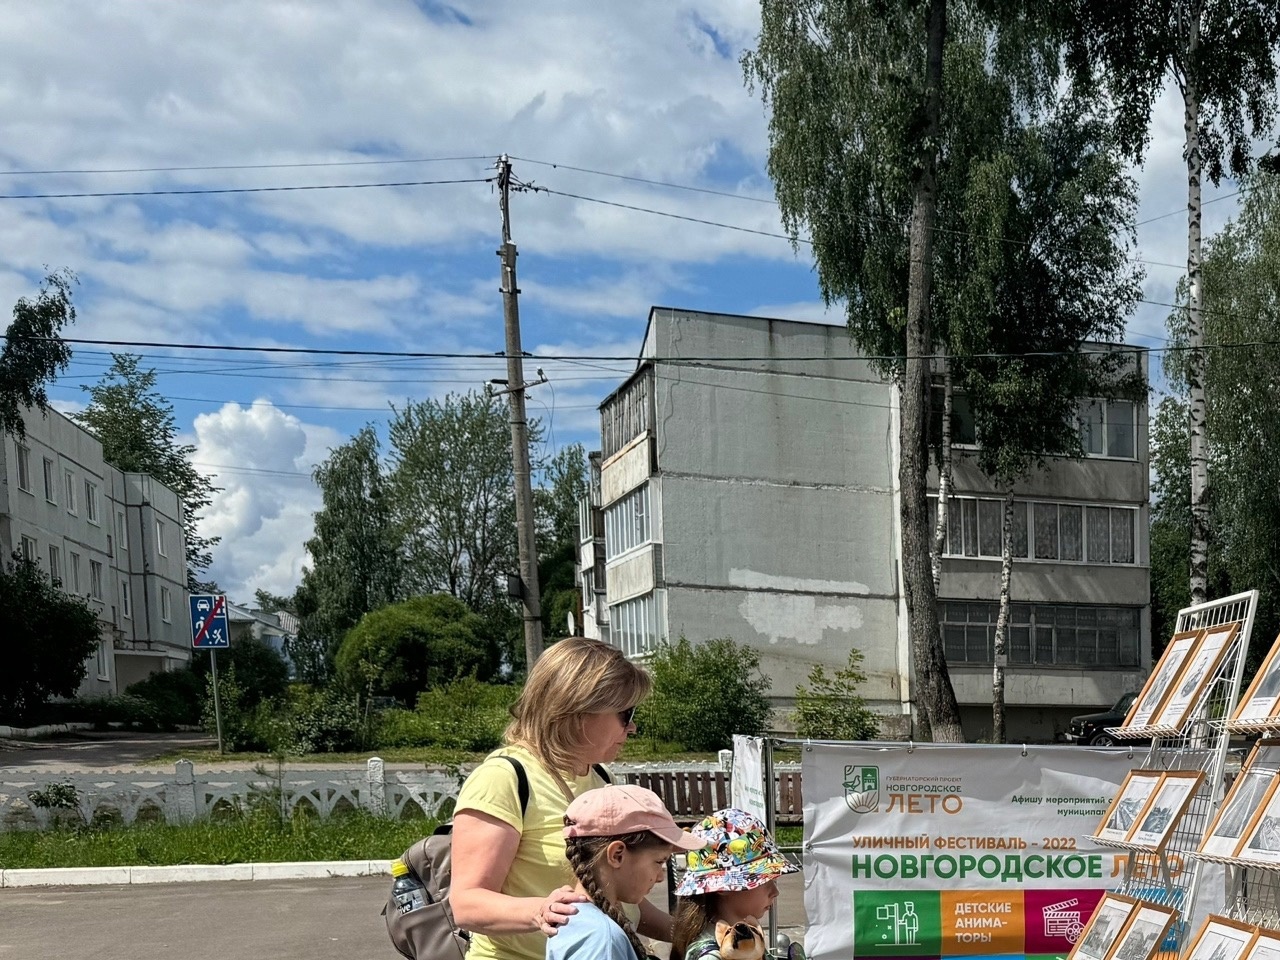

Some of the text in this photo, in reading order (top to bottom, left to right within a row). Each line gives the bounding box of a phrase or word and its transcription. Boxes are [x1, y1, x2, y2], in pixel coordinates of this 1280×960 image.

[886, 784, 962, 793] НОВГОРОДСКОЕ
[885, 793, 963, 815] ЛЕТО
[1011, 795, 1043, 805] Афишу
[1045, 797, 1106, 805] мероприятий
[1057, 808, 1107, 817] муниципал
[852, 833, 930, 850] УЛИЧНЫЙ
[933, 836, 1028, 850] ФЕСТИВАЛЬ
[1042, 837, 1077, 850] 2022
[852, 854, 1185, 883] НОВГОРОДСКОЕ ЛЕТО
[954, 902, 1012, 916] ДЕТСКИЕ
[955, 917, 1008, 929] АНИМА-
[955, 932, 992, 943] ТОРЫ
